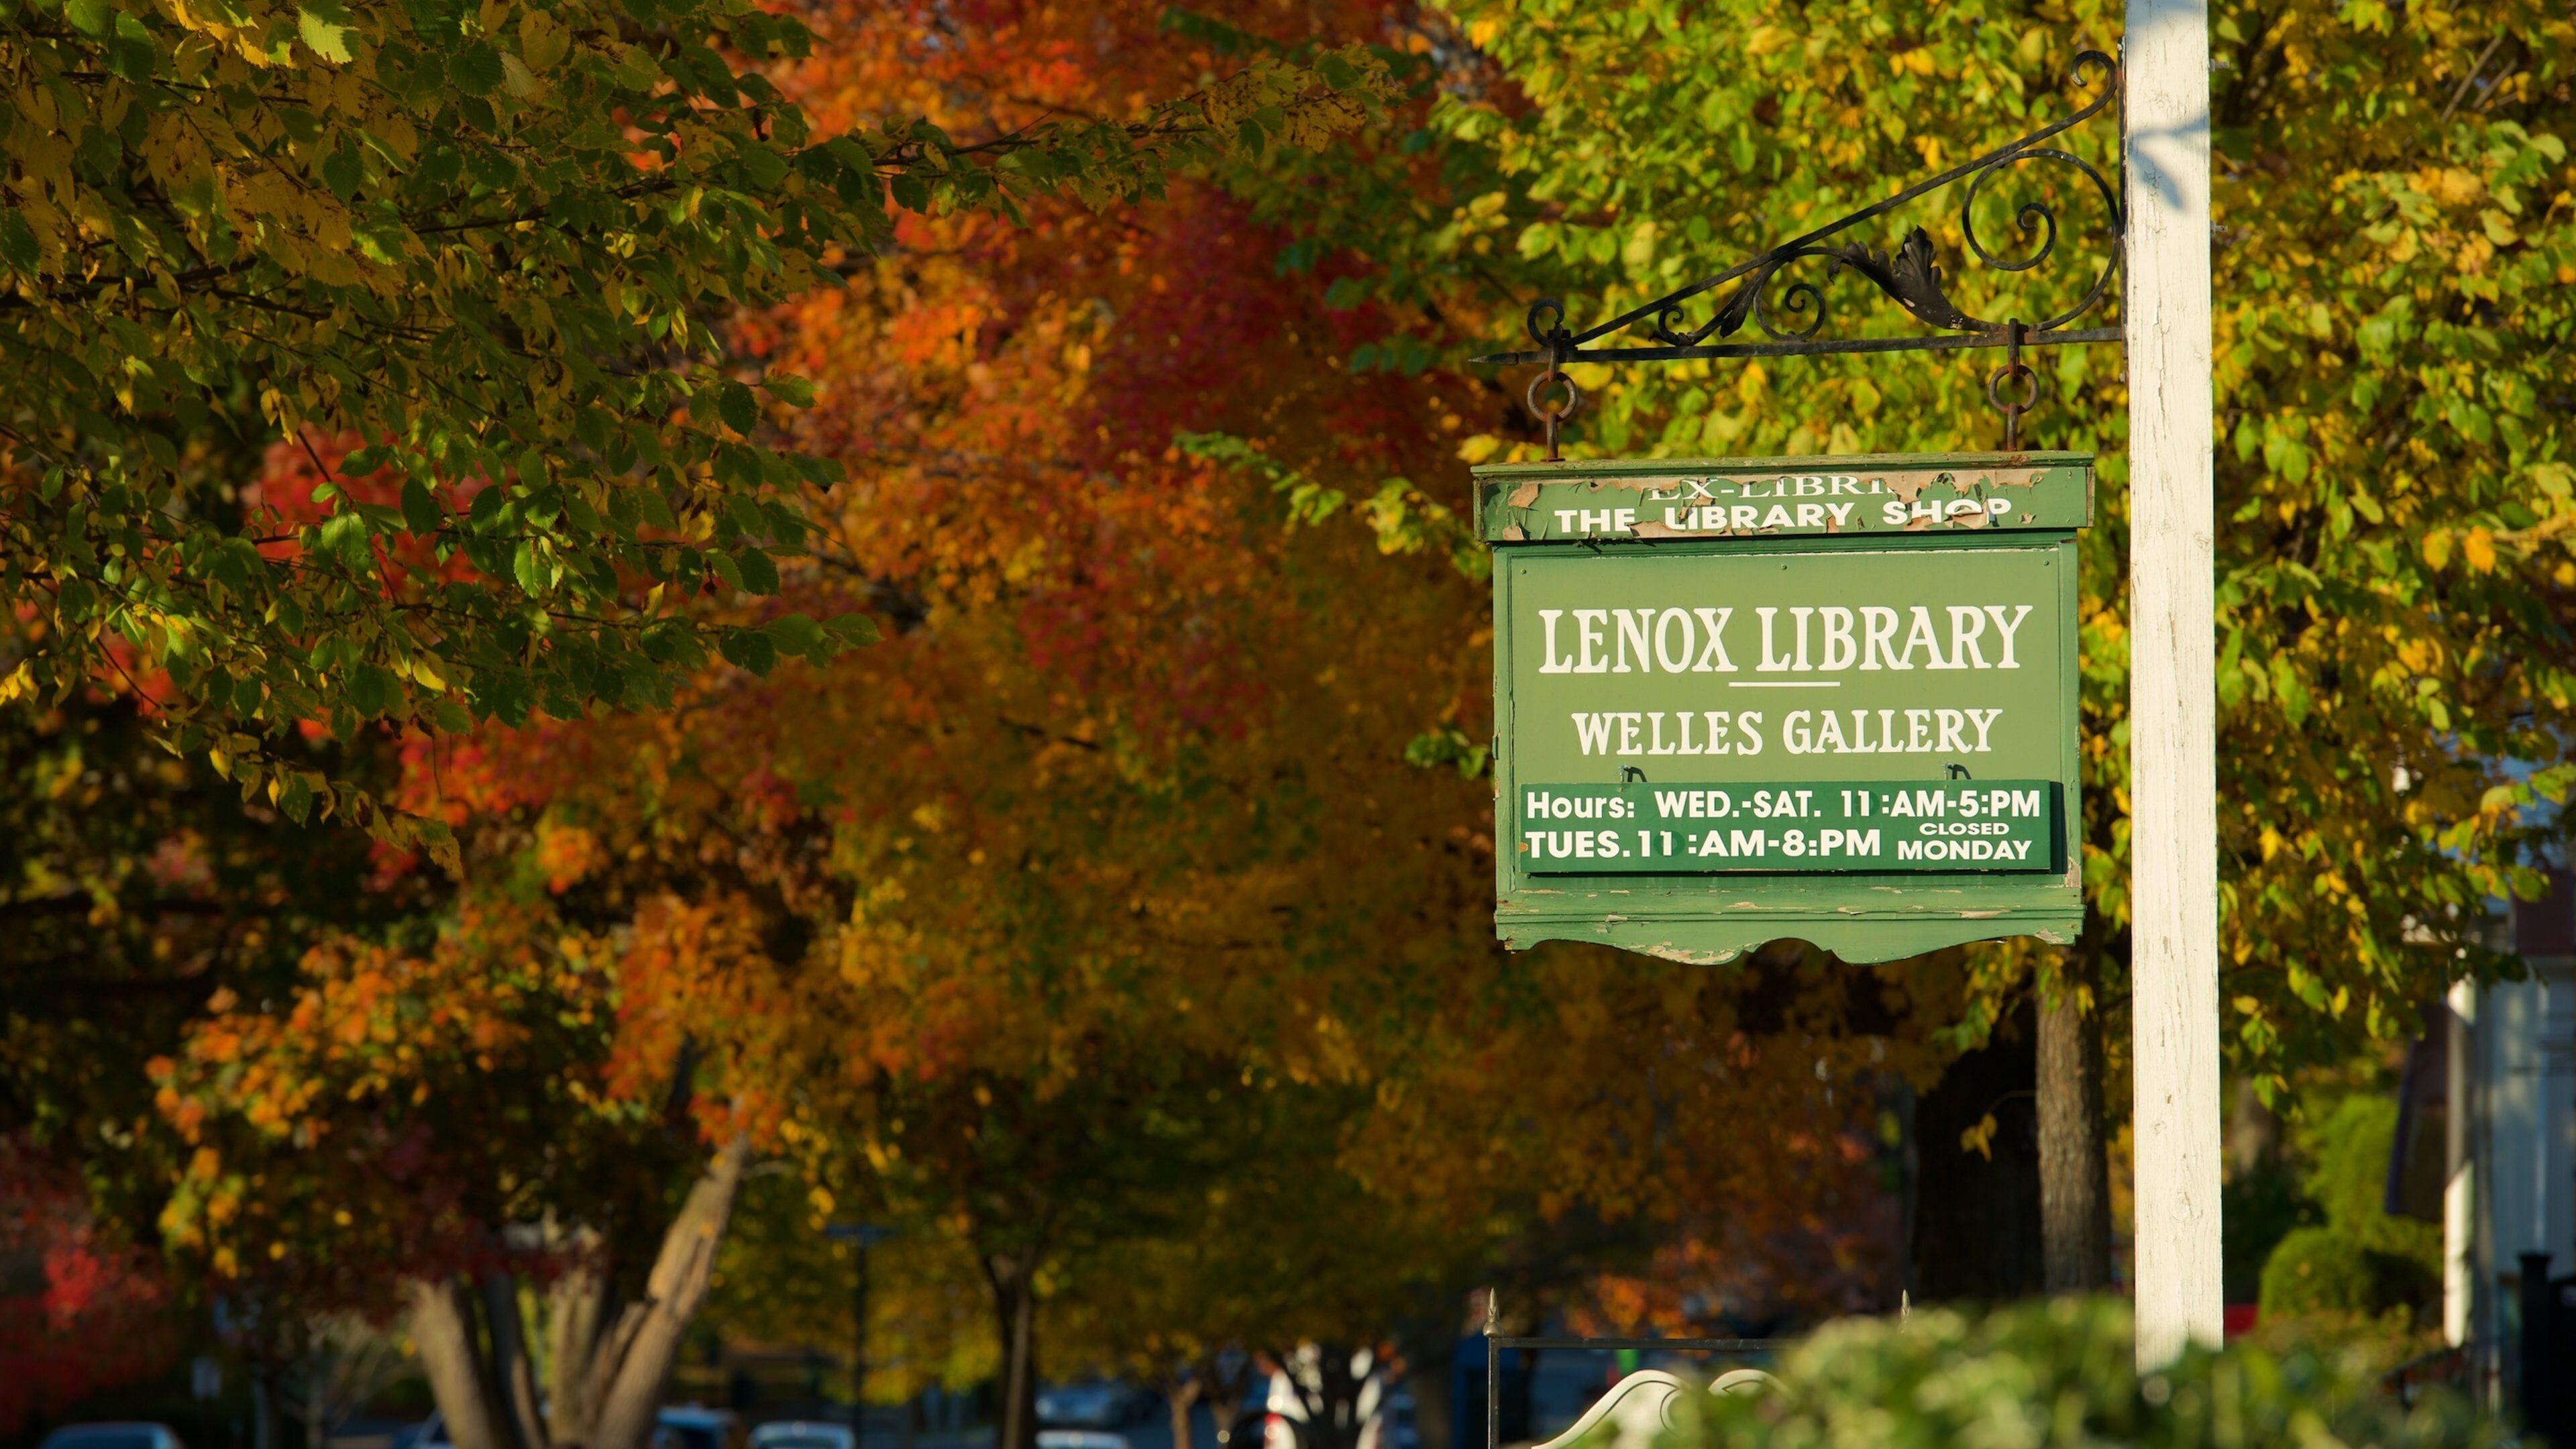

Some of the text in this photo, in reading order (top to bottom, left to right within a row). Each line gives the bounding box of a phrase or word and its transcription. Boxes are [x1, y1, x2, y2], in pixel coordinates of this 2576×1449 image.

[1648, 476, 1896, 500] EX-LIBRI
[1554, 508, 1635, 533] THE
[1664, 502, 1856, 530] LIBRARY
[1538, 604, 2033, 674] LENOX LIBRARY
[1571, 708, 2004, 756] WELLES GALLERY
[1527, 791, 1635, 818] Hours:
[1654, 790, 1821, 818] WED.-SAT.
[1919, 822, 2010, 836] CLOSED
[1525, 830, 1631, 859] TUES.
[1898, 840, 2033, 861] MONDAY
